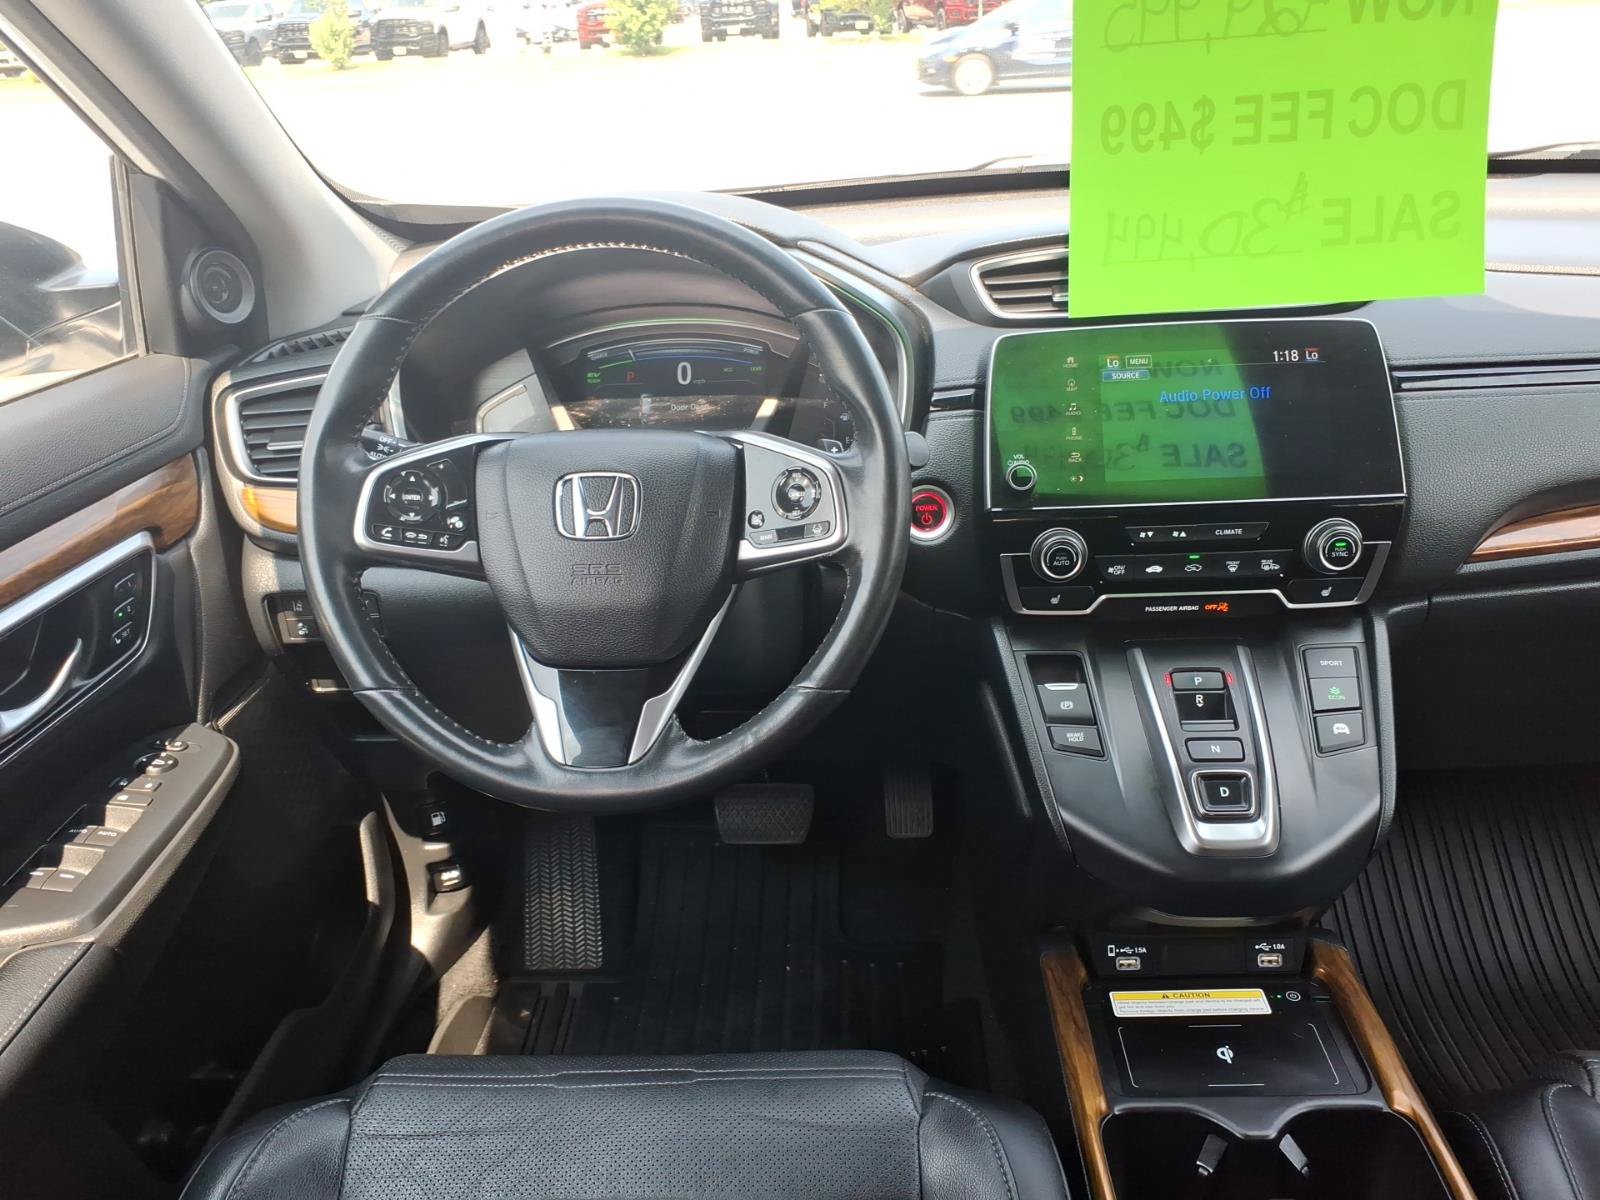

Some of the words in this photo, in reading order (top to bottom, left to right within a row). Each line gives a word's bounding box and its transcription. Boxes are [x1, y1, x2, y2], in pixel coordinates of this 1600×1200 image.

[1272, 349, 1299, 362] 1:18
[1305, 350, 1319, 360] Lo
[1107, 359, 1120, 368] Lo
[1129, 358, 1149, 366] MENU
[626, 371, 637, 382] P
[677, 361, 692, 385] 0
[1111, 372, 1140, 380] SOURCE
[1160, 390, 1198, 403] Audio
[1202, 388, 1245, 401] Power
[1250, 386, 1272, 399] Off
[1215, 528, 1243, 536] CLIMATE
[1194, 676, 1202, 685] P
[1195, 694, 1204, 704] R
[1211, 745, 1221, 753] N
[1219, 787, 1230, 797] D
